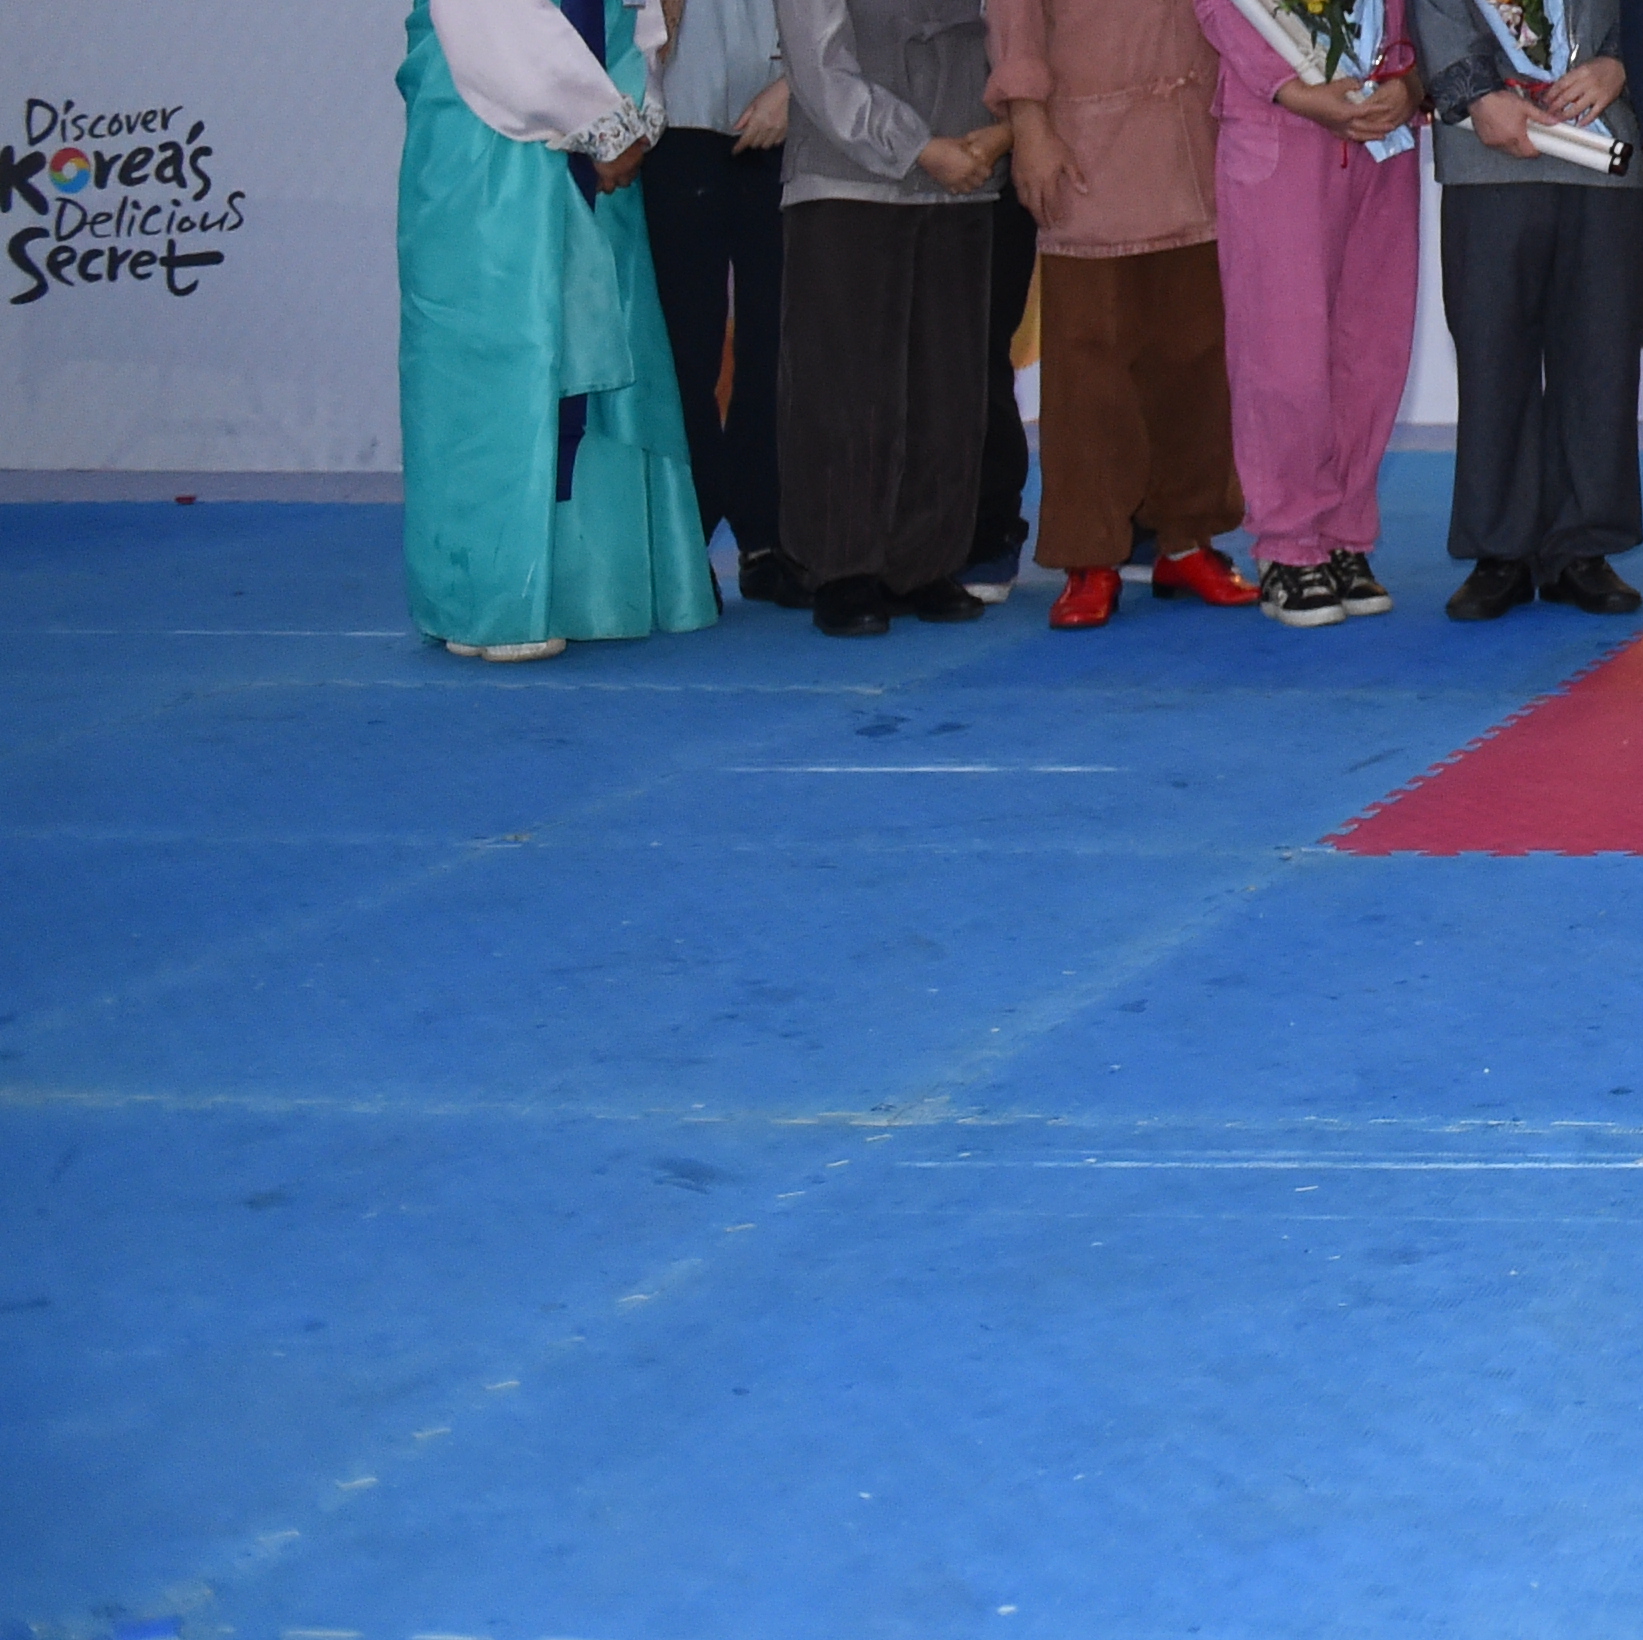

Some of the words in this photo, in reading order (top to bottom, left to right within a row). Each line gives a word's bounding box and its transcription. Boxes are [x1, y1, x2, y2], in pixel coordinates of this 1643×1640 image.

[25, 97, 183, 147] Discover
[0, 120, 213, 216] Korea's
[54, 190, 246, 242] Delicious
[8, 226, 225, 305] Secret
